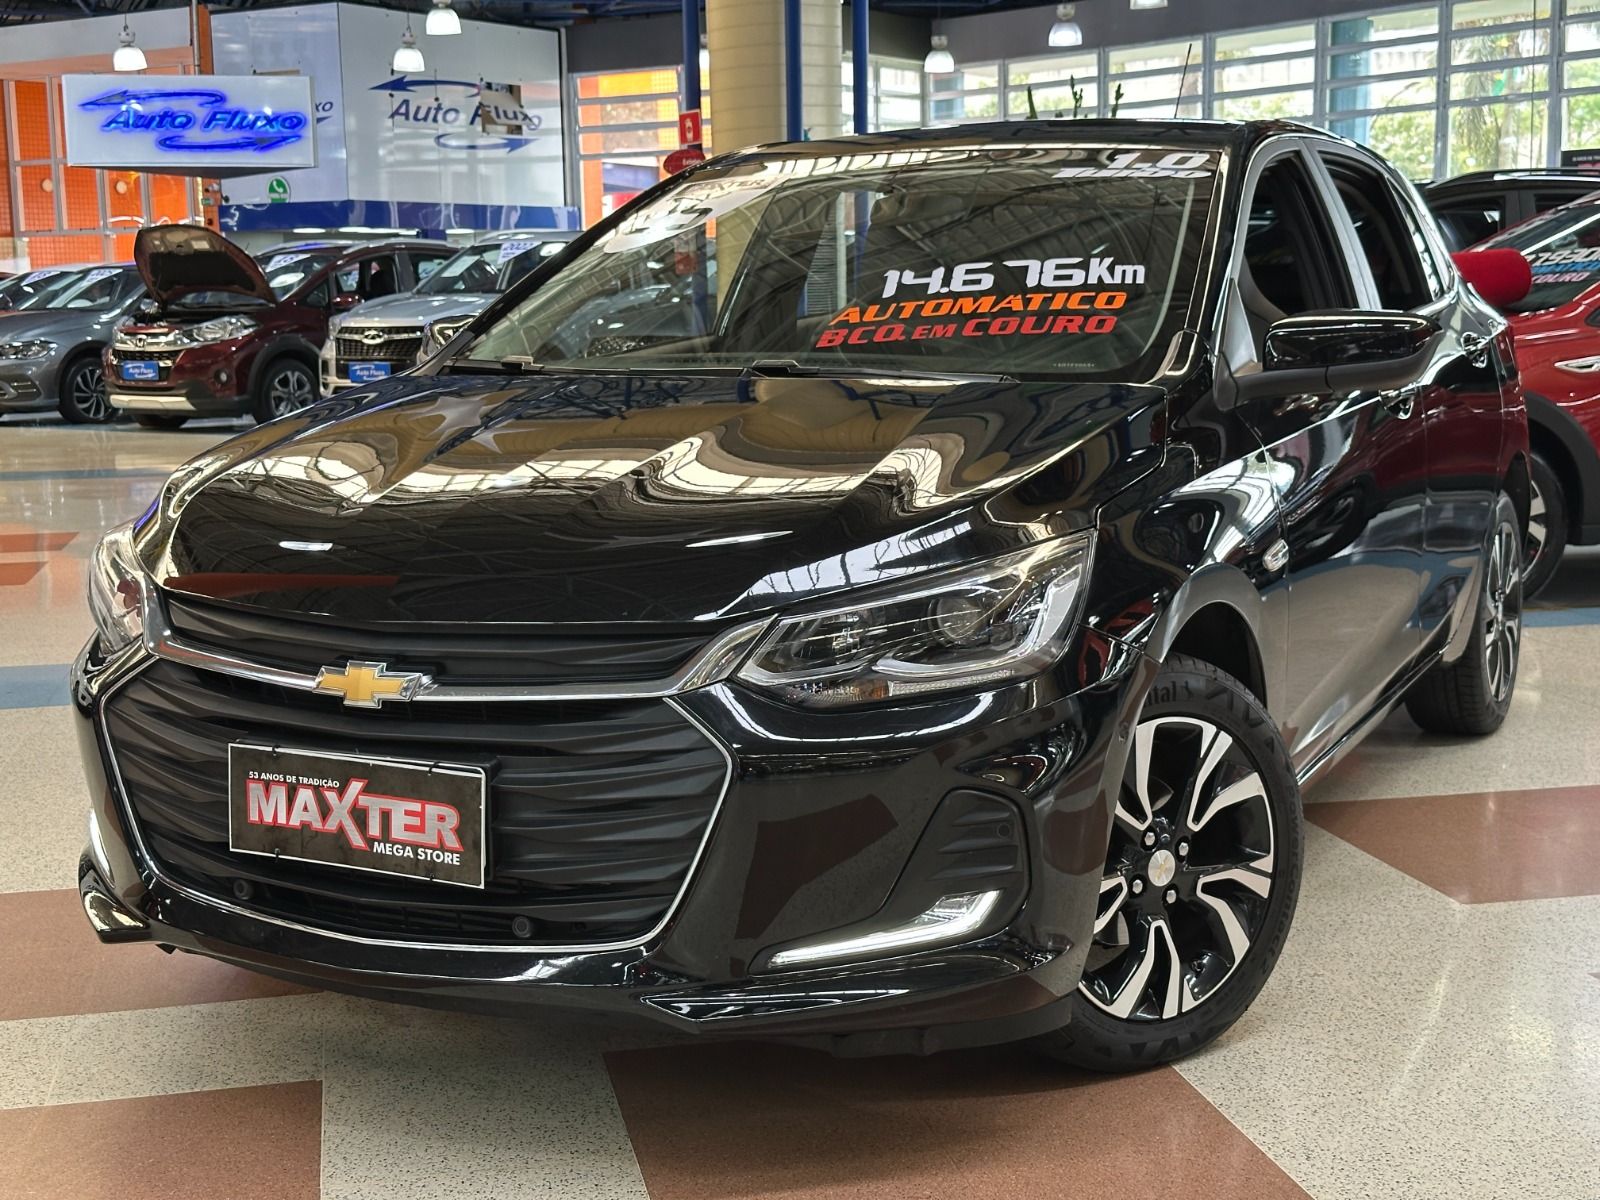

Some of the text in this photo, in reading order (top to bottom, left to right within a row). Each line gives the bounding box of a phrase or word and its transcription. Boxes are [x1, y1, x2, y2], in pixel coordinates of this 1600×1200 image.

[103, 108, 304, 131] Auto Fluxo
[388, 98, 460, 123] Auto
[1107, 152, 1210, 169] 1.0
[911, 323, 957, 340] EM
[962, 315, 1118, 337] COURO
[248, 771, 340, 789] 53 ANOS DE TRADIÇÃO
[246, 778, 464, 851] MAXTER
[373, 841, 461, 866] MEGA STORE
